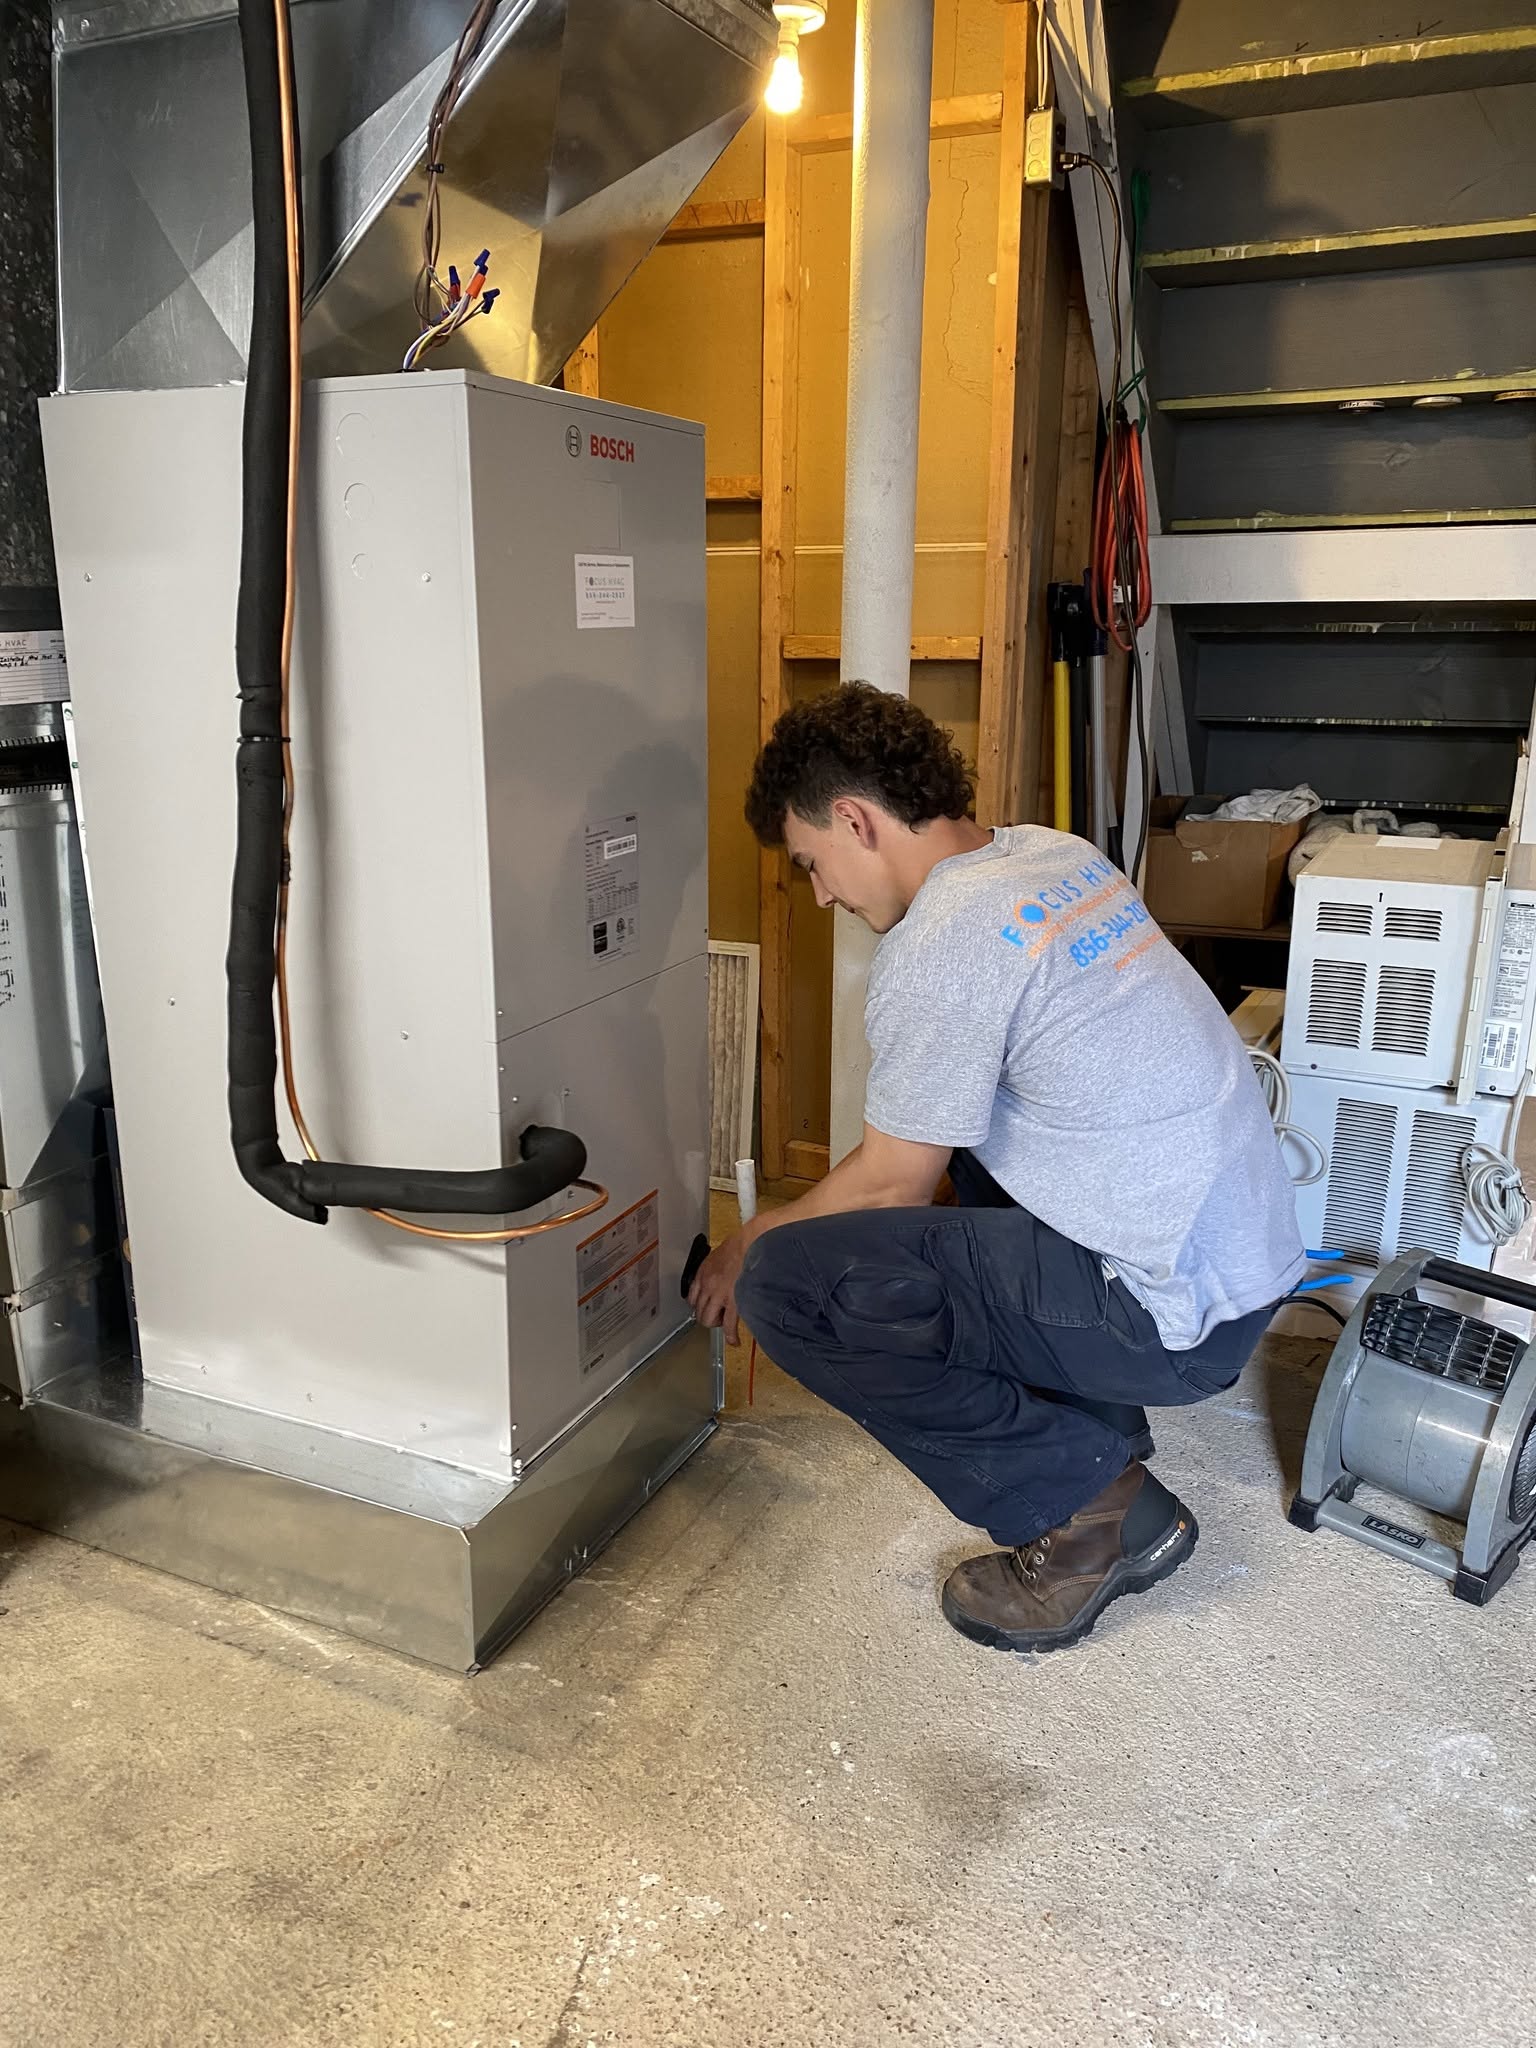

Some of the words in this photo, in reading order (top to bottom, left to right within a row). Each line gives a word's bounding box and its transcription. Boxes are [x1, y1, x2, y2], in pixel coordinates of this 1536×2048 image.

[590, 433, 635, 463] BOSCH
[5, 639, 27, 647] HVAC
[1000, 879, 1083, 948] FOCUS
[1069, 899, 1150, 968] 856-344-20
[1150, 1528, 1182, 1561] carhartt
[1369, 1520, 1419, 1544] LASKO
